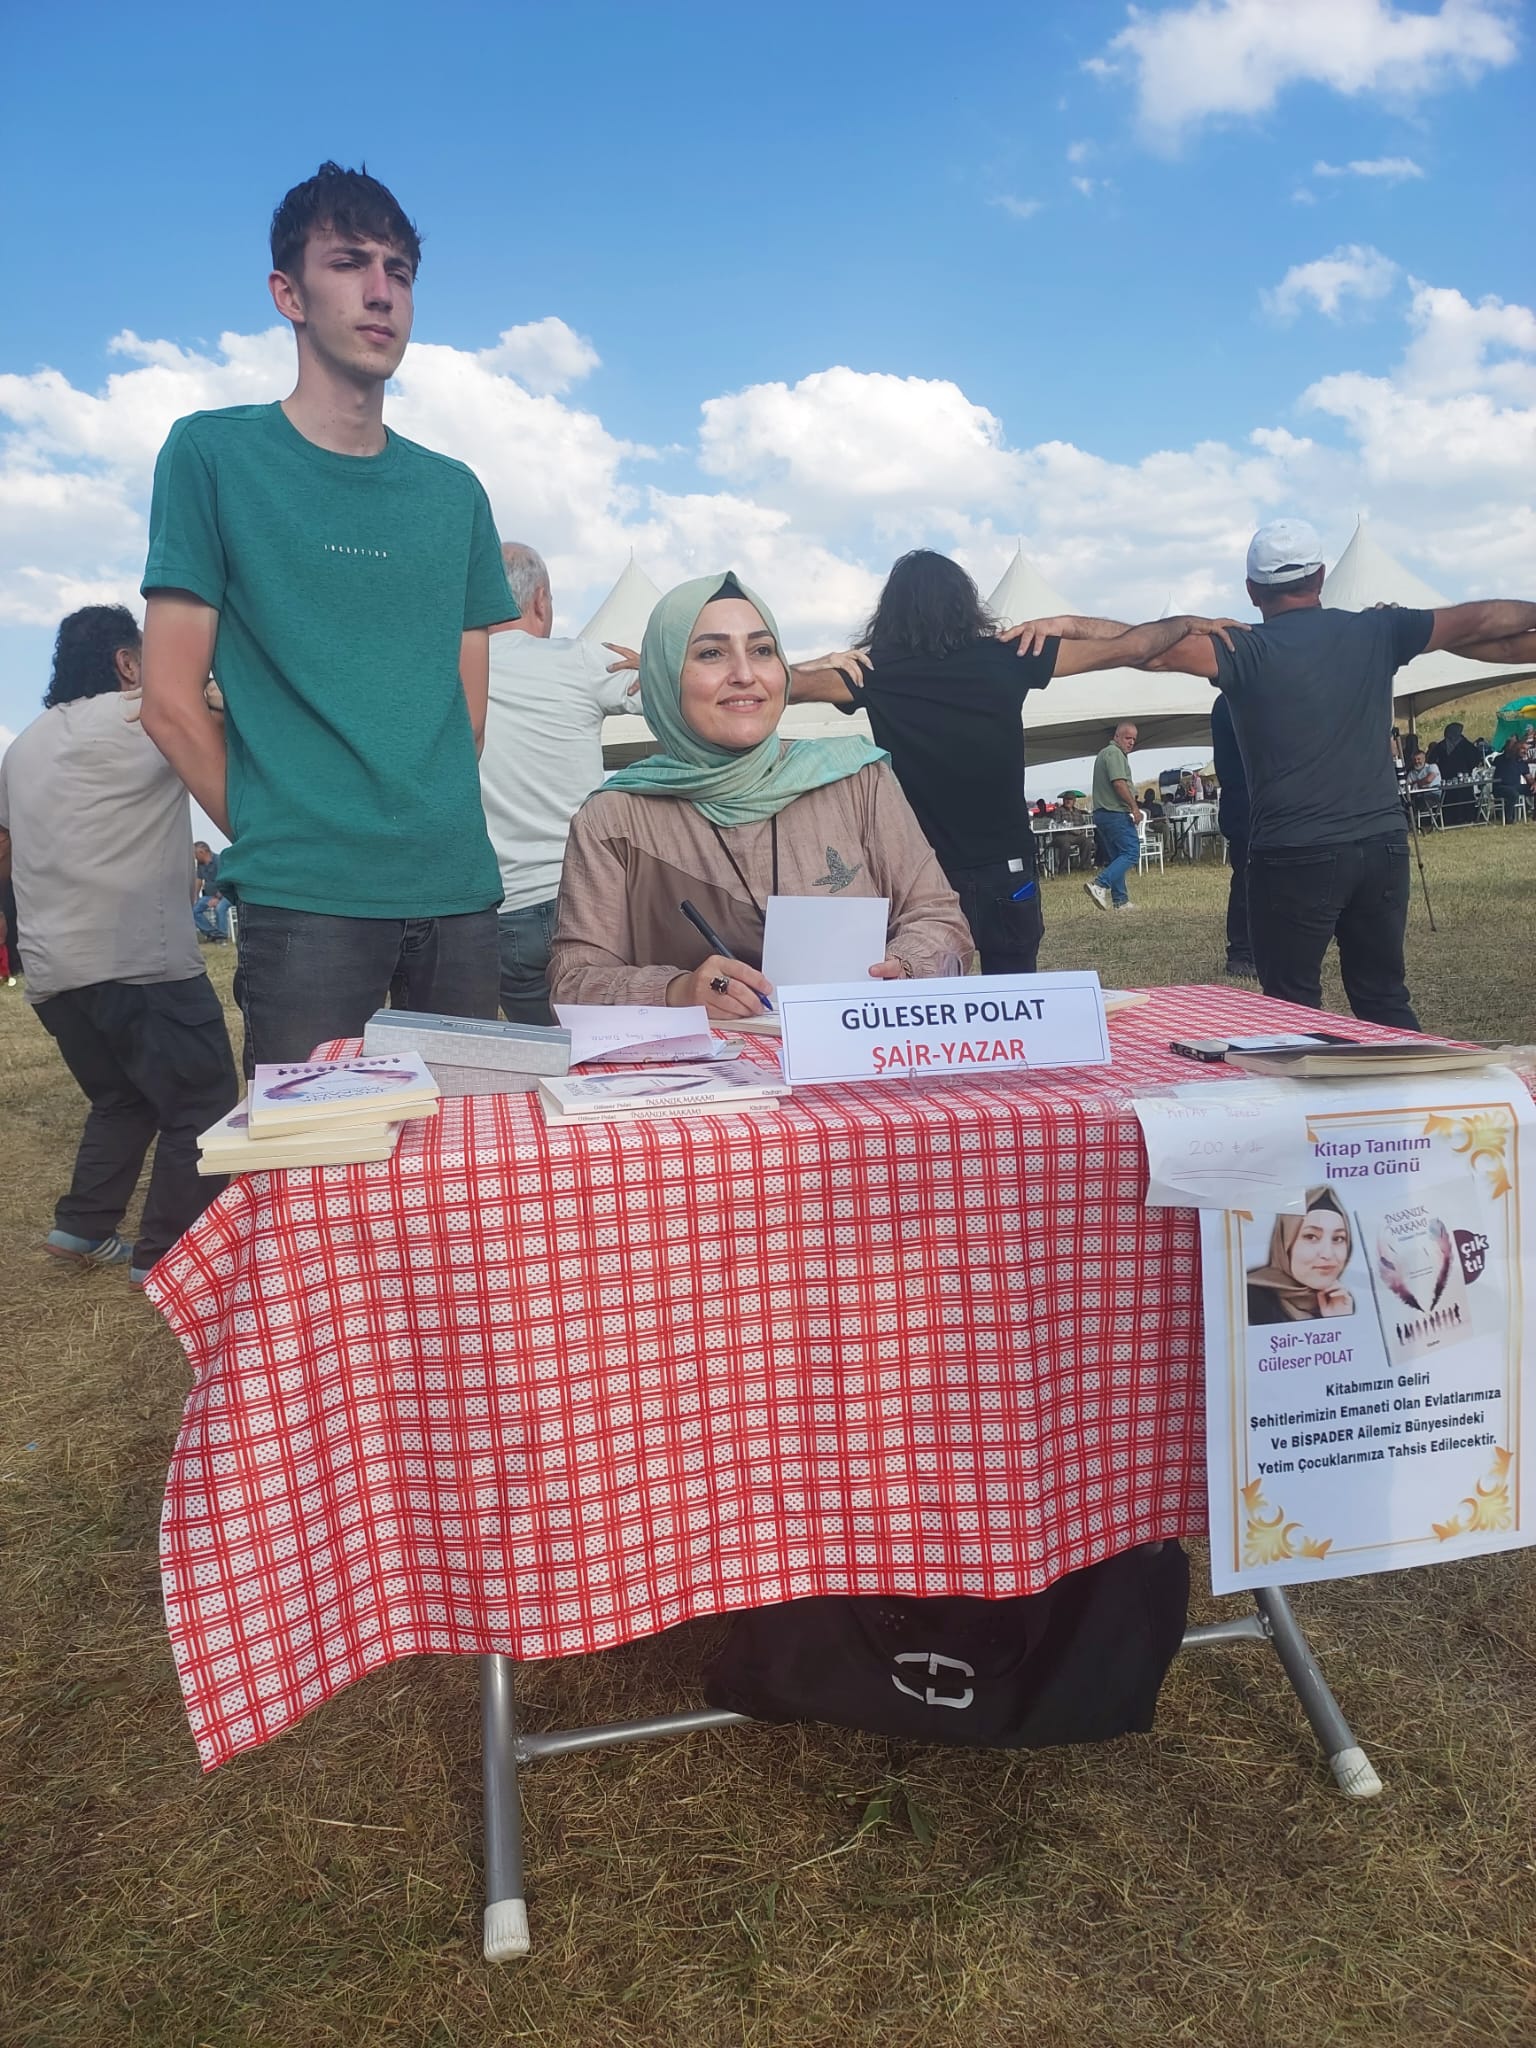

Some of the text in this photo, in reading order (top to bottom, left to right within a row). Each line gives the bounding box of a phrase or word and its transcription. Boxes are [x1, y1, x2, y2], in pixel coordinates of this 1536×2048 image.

[841, 999, 1046, 1031] GÜLESER POLAT
[872, 1039, 1026, 1074] ŞAİR-YAZAR
[1188, 1140, 1225, 1156] 200
[1314, 1137, 1431, 1158] Kitap Tanıtım
[1326, 1157, 1421, 1179] İmza Günü
[1460, 1235, 1489, 1258] çık
[1464, 1255, 1485, 1273] tı!
[1269, 1331, 1343, 1353] Şair-Yazar
[1258, 1348, 1355, 1373] Güleser POLAT
[1325, 1371, 1431, 1397] Kitabımızın Geliri
[1249, 1388, 1502, 1432] Şehitlerimizin Emaneti Olan Evlatlarımıza
[1270, 1410, 1485, 1450] Ve BİSPADER Ailemiz Bünyesindeki
[1257, 1432, 1498, 1475] Yetim Çocuklarımıza Tahsis Edilecektir.
